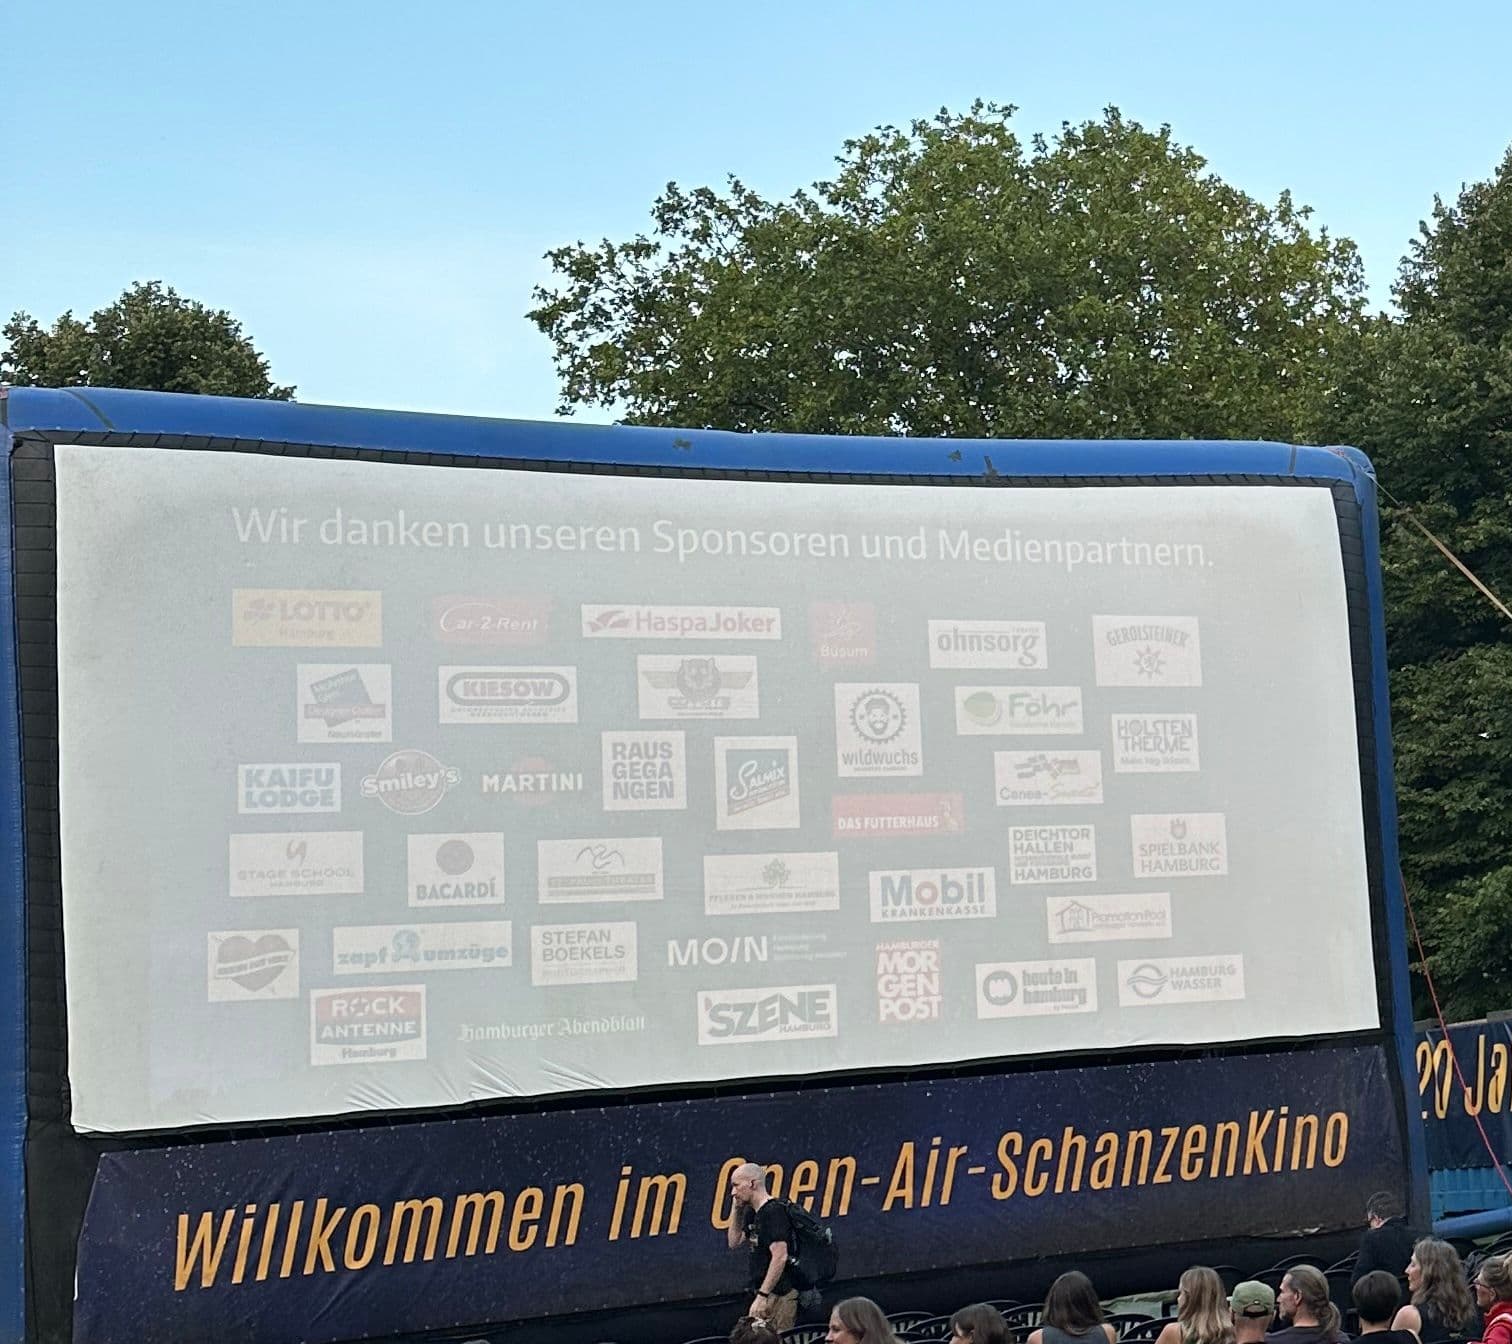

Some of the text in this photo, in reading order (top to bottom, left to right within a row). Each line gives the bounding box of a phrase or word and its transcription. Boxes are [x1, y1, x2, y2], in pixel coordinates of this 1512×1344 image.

[233, 506, 1214, 573] Wir danken unseren Sponsoren und Medienpartnern.
[279, 599, 366, 622] LOTTO
[1106, 625, 1191, 647] GEROLSTEINER
[937, 628, 1041, 668] ohnsorg
[463, 680, 554, 697] KIESOW
[1008, 692, 1078, 718] Föhr
[1117, 719, 1193, 737] HOLSTEN
[612, 742, 673, 760] RAUS
[1121, 736, 1191, 754] THERME
[842, 748, 918, 766] wildwuchs
[245, 768, 335, 788] KAIFU
[612, 762, 673, 780] GEGA
[362, 768, 461, 795] Smiley's
[482, 773, 584, 793] MARTINI
[613, 782, 674, 800] NGEN
[245, 789, 335, 808] LODGE
[839, 815, 939, 830] DAS FUTTERHAUS
[1013, 828, 1091, 842] DEICHTOR
[1014, 842, 1074, 855] HALLEN
[1139, 841, 1221, 858] SPIELBANK
[238, 867, 354, 881] STAGE SCHOOL
[1014, 866, 1093, 882] HAMBURG
[1141, 858, 1221, 874] HAMBURG
[416, 877, 497, 900] BACARDÍ
[880, 873, 985, 907] Mobil
[881, 905, 986, 918] KRANKENKASSE
[542, 929, 611, 945] STEFAN
[337, 944, 388, 969] zapf
[542, 945, 626, 962] BOEKELS
[877, 951, 940, 974] MOR
[1022, 967, 1078, 986] heute in
[1170, 963, 1236, 978] HAMBURG
[878, 974, 941, 998] GEN
[1171, 977, 1223, 991] WASSER
[331, 996, 406, 1017] ROCK
[707, 990, 831, 1038] SZENE
[879, 997, 942, 1022] POST
[321, 1021, 417, 1040] ANTENNE
[173, 1183, 585, 1292] Willkommen
[608, 1164, 687, 1242] im
